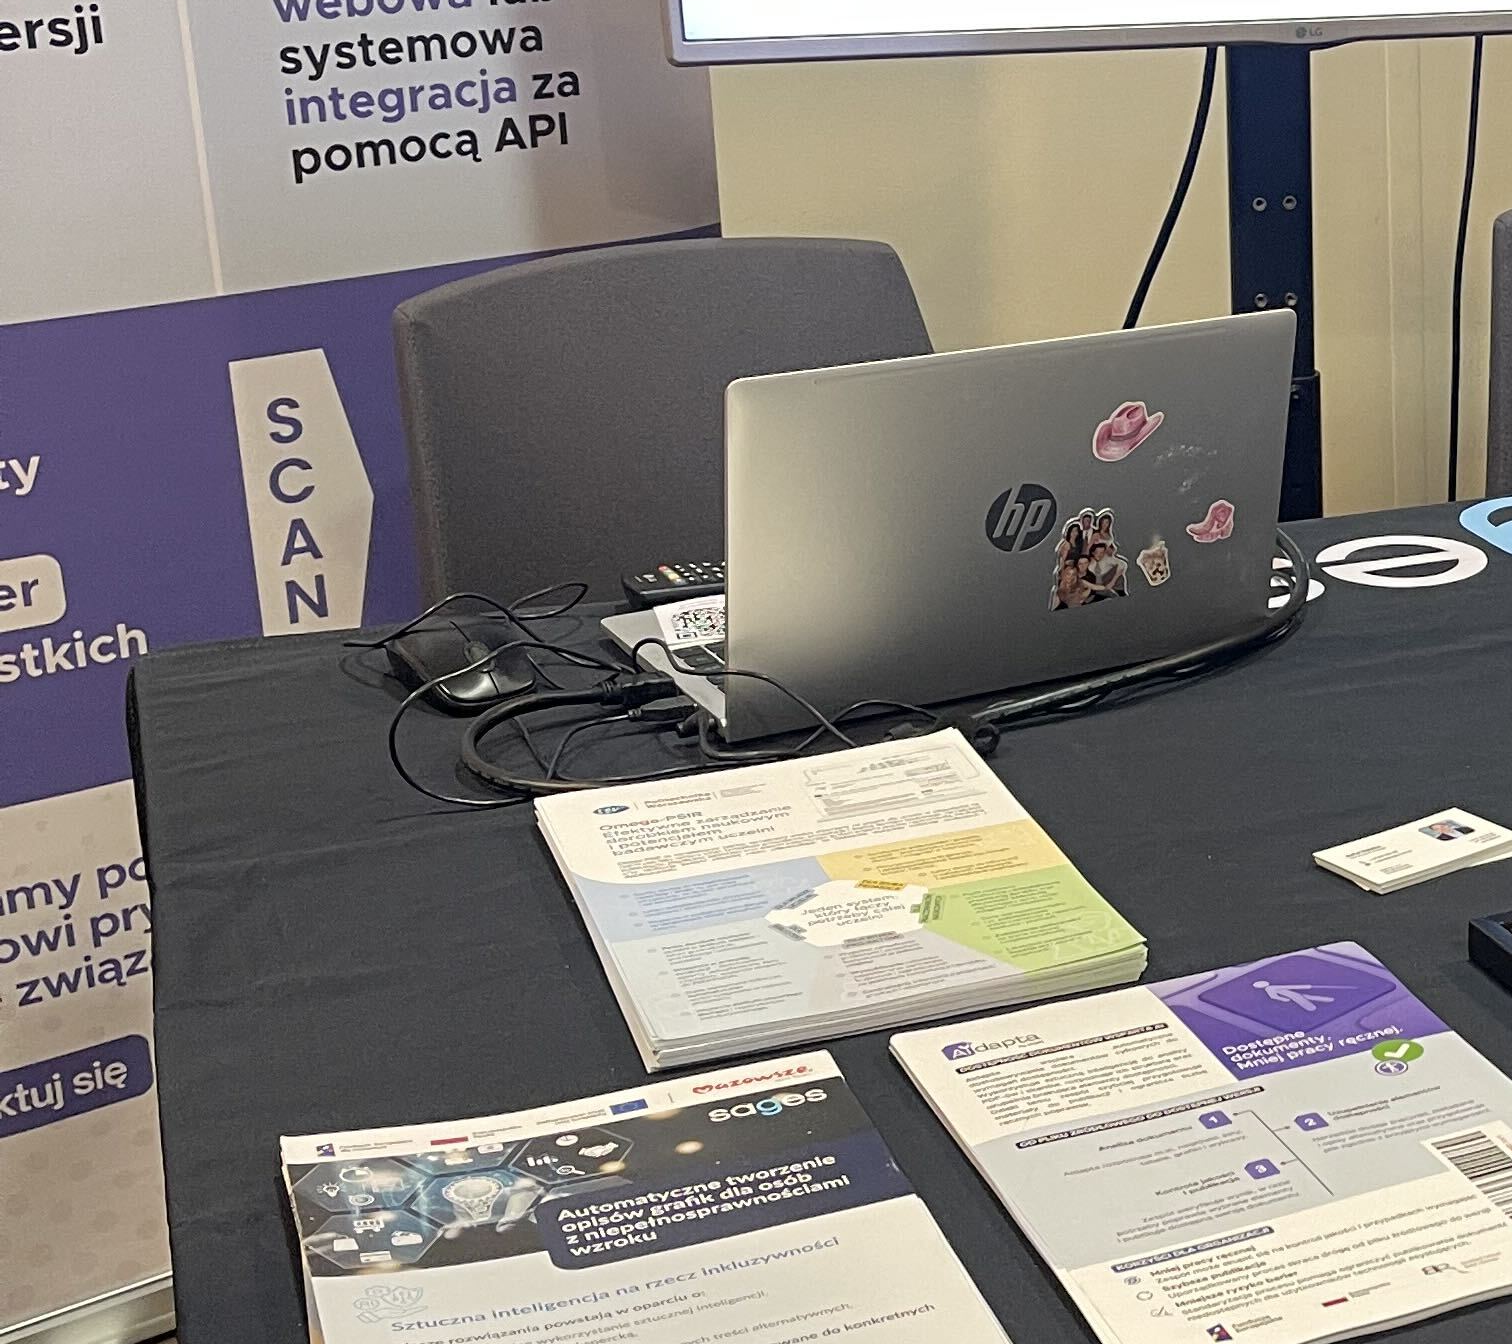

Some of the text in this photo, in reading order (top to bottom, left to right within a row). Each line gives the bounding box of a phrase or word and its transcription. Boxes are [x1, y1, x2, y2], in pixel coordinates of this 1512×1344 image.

[279, 20, 545, 80] systemowa
[284, 66, 581, 127] integracja za
[291, 112, 570, 184] pomocą API
[266, 397, 329, 625] SCAN
[992, 483, 1051, 552] hp
[0, 872, 81, 916] my
[16, 949, 149, 1007] związ
[1222, 1031, 1305, 1055] Dostępne
[1236, 1054, 1284, 1071] Mniej
[1287, 1041, 1334, 1061] pracy
[73, 1061, 127, 1095] się
[708, 1088, 828, 1122] sages
[1304, 1117, 1317, 1127] 2
[558, 1156, 836, 1222] Automatyczne tworzenie
[1255, 1163, 1267, 1174] 3
[561, 1173, 812, 1234] opisów grafik dla osób
[565, 1174, 850, 1245] z niepełnosprawnościami
[570, 1230, 658, 1256] wzroku
[392, 1237, 840, 1332] Sztuczna inteligencja na rzecz inkluzywności
[449, 1325, 540, 1344] rozwiązania
[544, 1311, 612, 1331] powstają
[616, 1308, 629, 1316] w
[633, 1294, 688, 1313] oparciu
[634, 1307, 693, 1327] sztucznej
[822, 1326, 841, 1336] do
[844, 1303, 935, 1331] konkretnych
